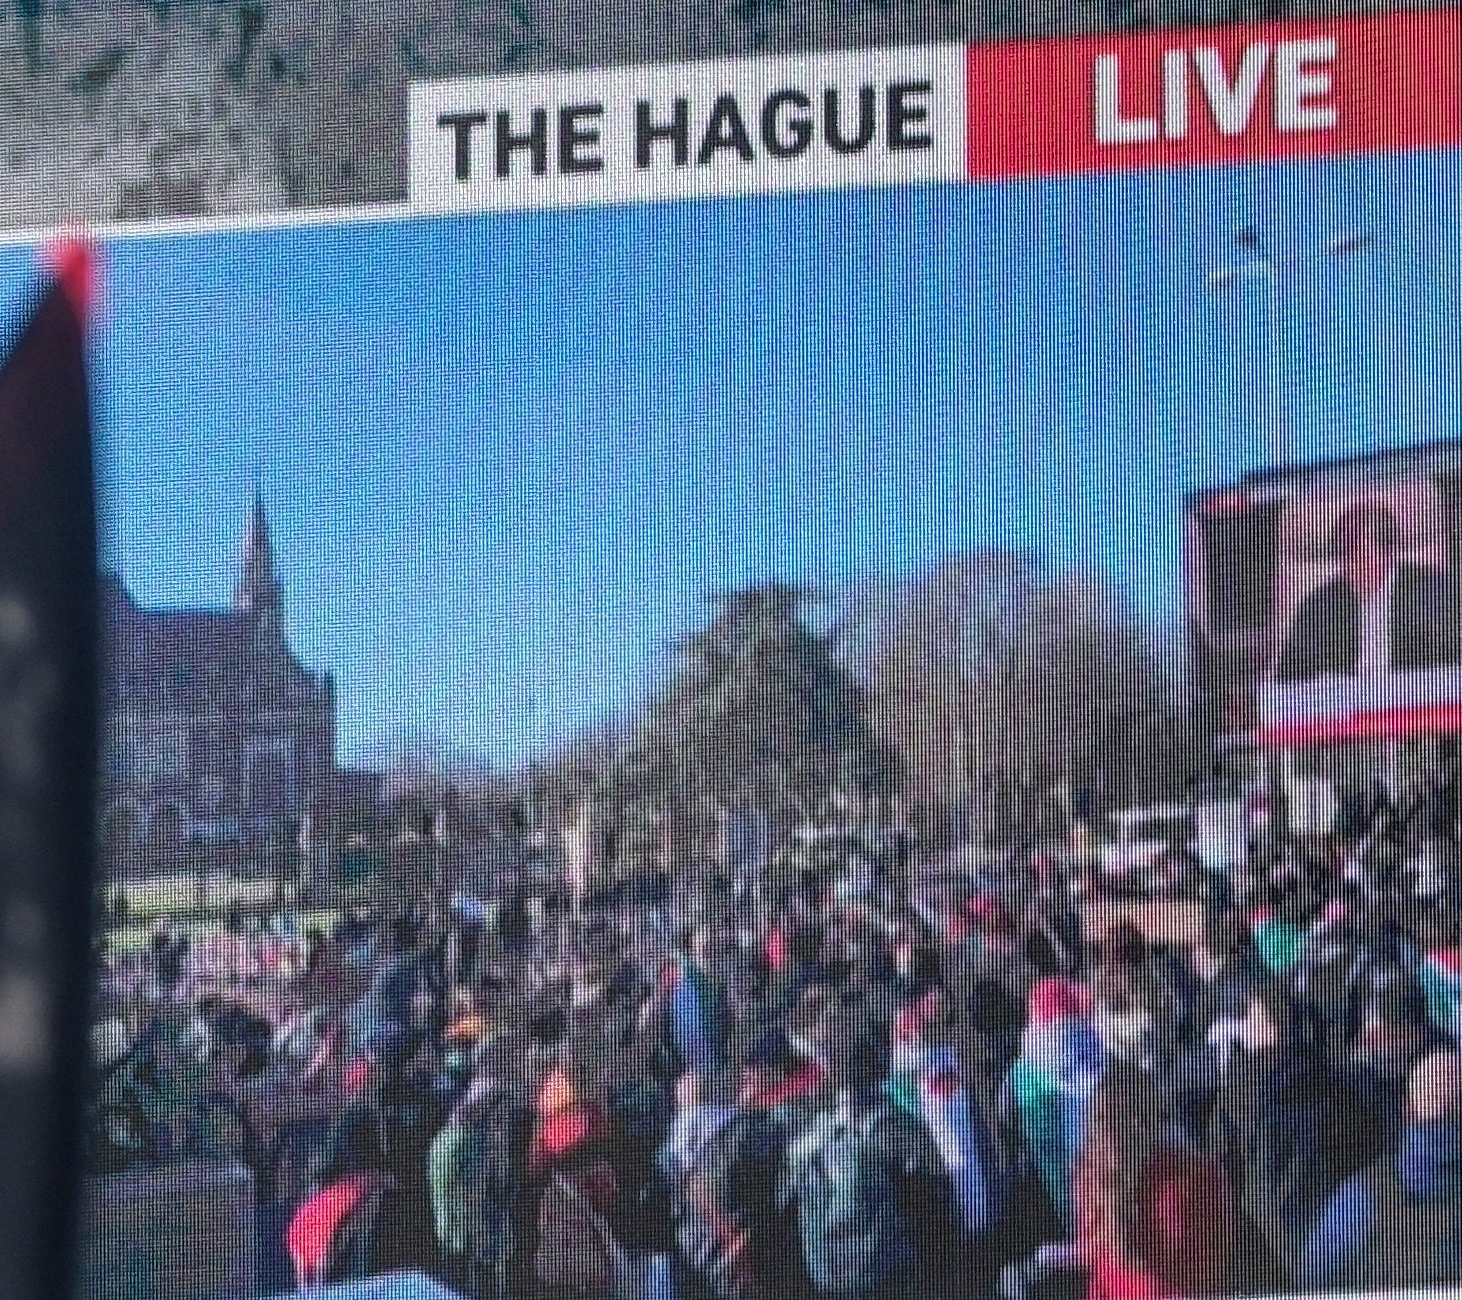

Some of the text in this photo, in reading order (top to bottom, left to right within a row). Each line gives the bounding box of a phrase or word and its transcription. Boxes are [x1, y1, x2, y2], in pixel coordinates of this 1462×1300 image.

[438, 81, 934, 182] THE HAGUE
[1092, 39, 1338, 146] LIVE
